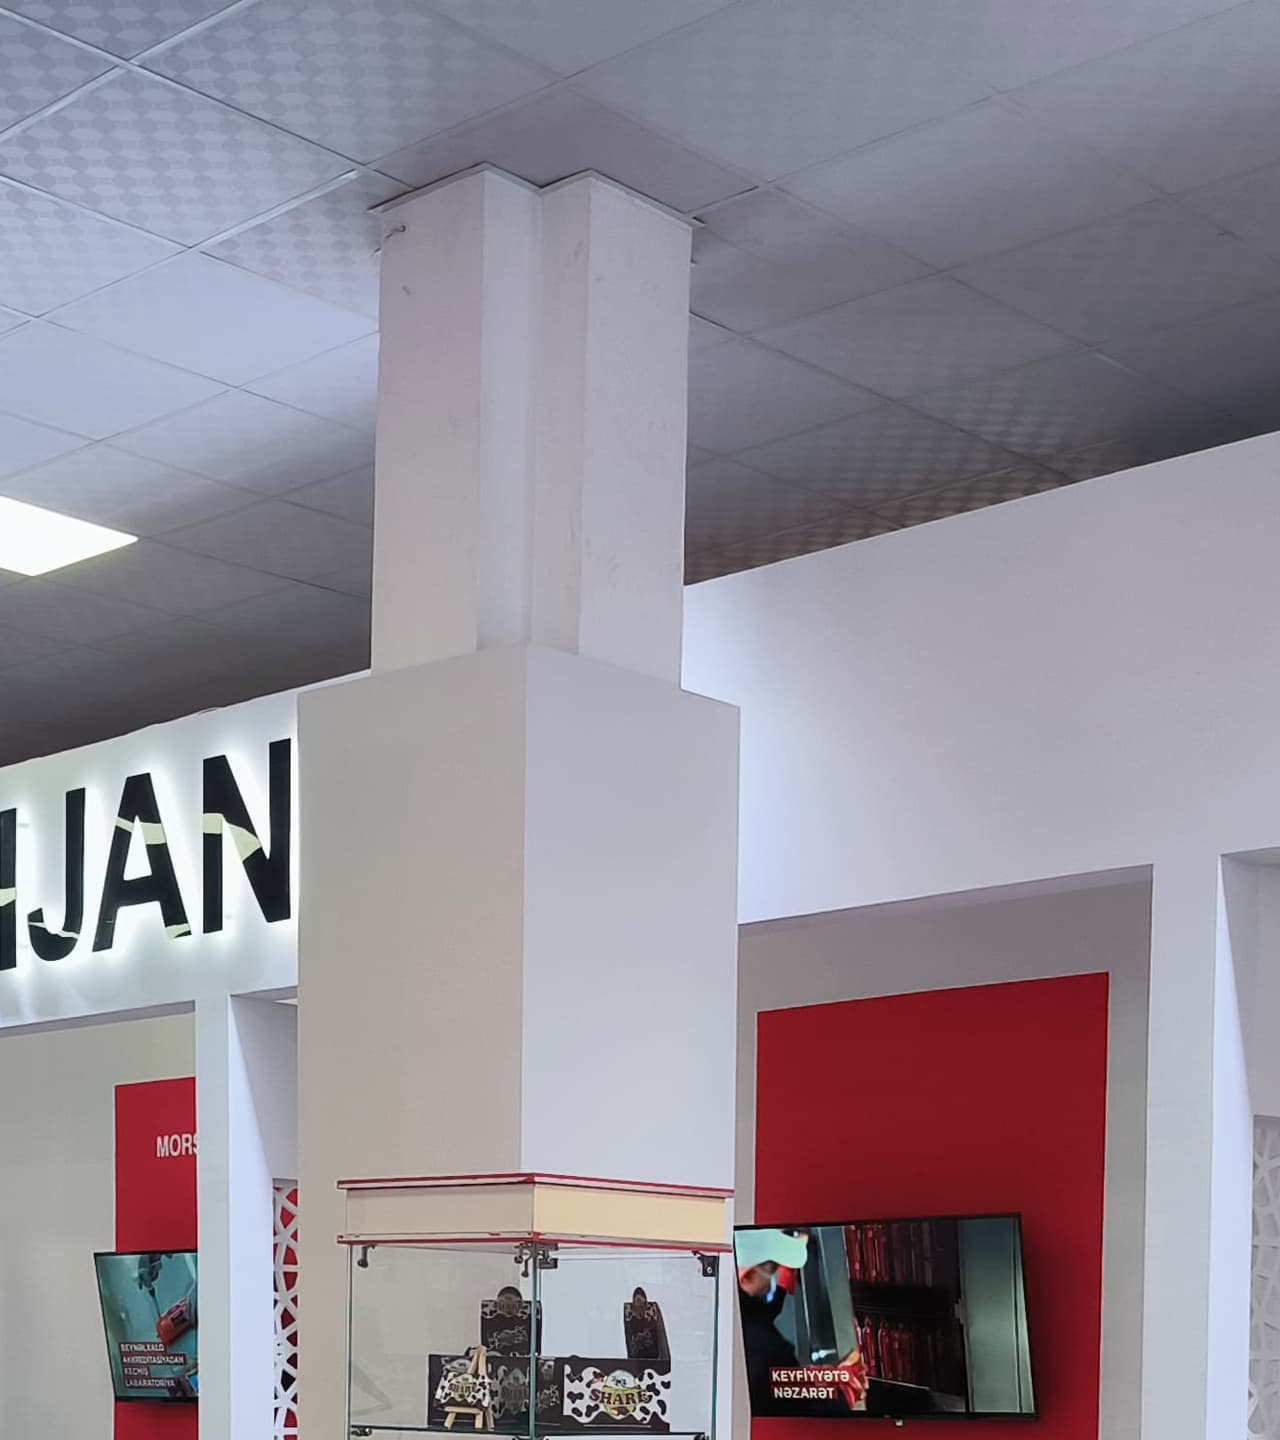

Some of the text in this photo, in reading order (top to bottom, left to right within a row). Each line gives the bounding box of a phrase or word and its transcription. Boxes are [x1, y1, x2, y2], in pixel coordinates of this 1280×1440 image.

[771, 1367, 850, 1384] KEYFİYYƏTƏ
[590, 1388, 650, 1405] SHARE
[773, 1386, 835, 1400] NƏZARƏT
